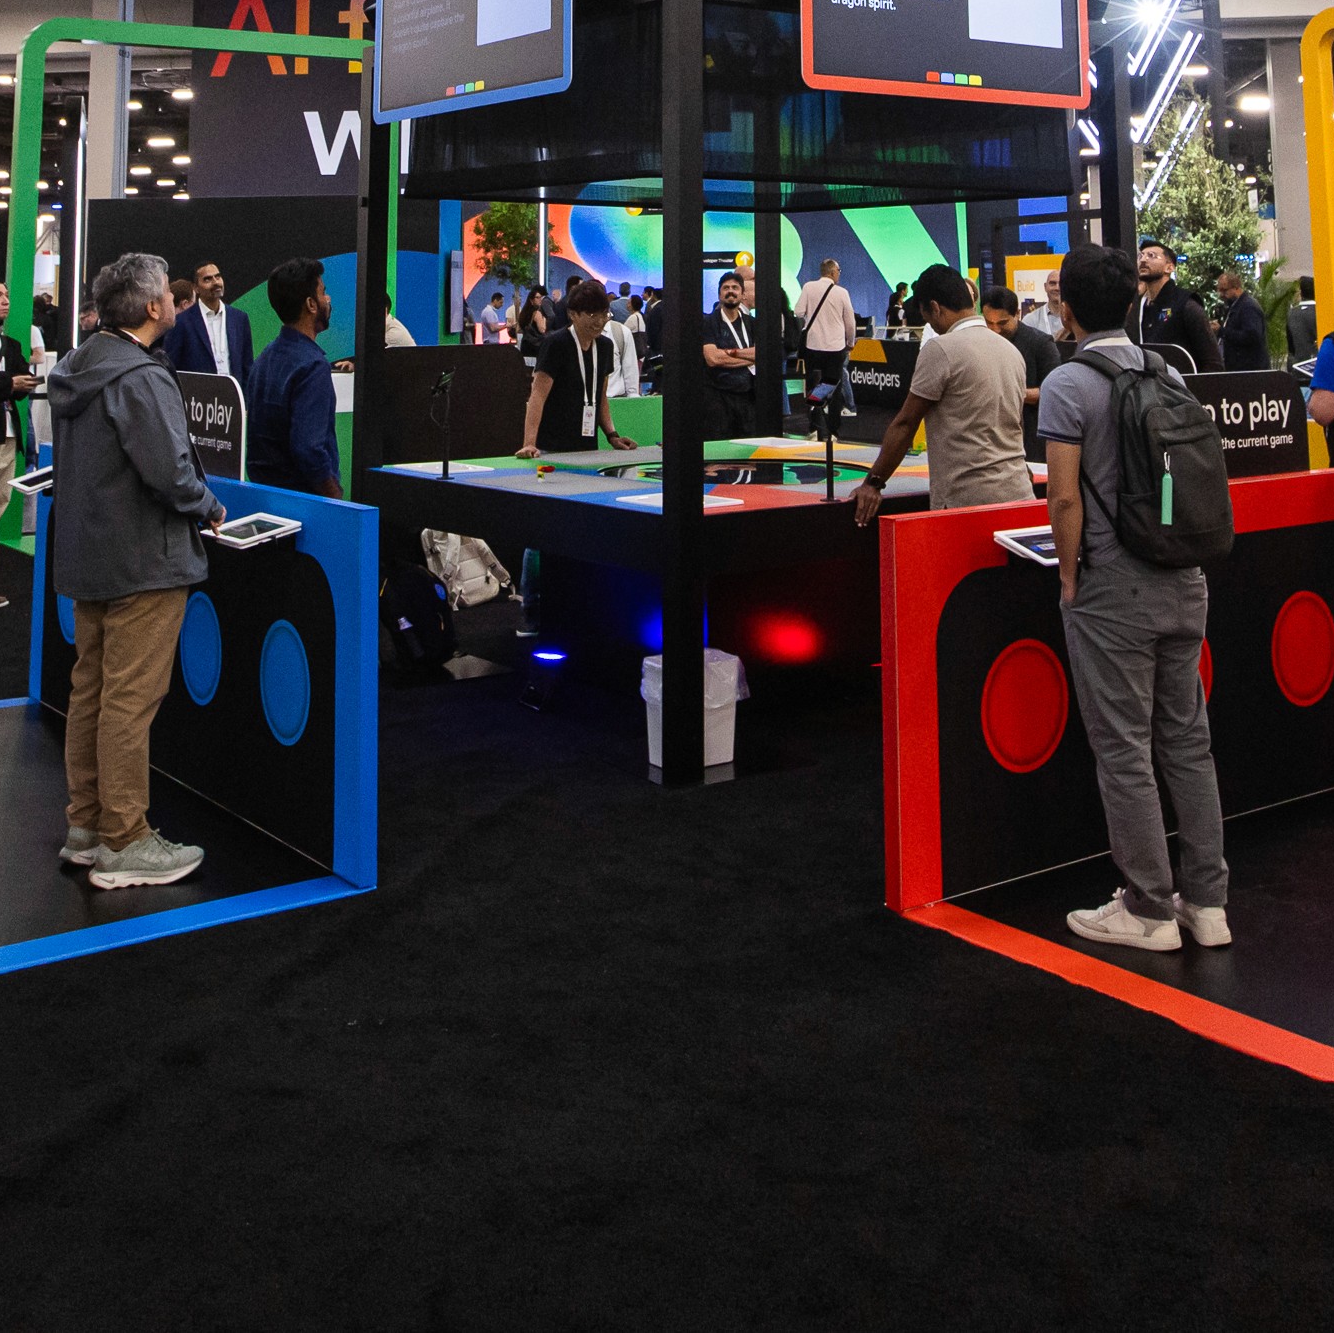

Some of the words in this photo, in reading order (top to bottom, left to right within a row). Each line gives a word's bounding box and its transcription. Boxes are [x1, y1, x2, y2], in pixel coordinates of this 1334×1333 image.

[850, 367, 901, 391] developers
[191, 396, 204, 423] to
[205, 396, 233, 434] play
[1220, 398, 1244, 425] to
[1248, 393, 1292, 431] play
[197, 436, 217, 448] current
[217, 438, 232, 452] game
[1221, 437, 1236, 450] the
[1237, 434, 1269, 449] current
[1270, 434, 1294, 449] game
